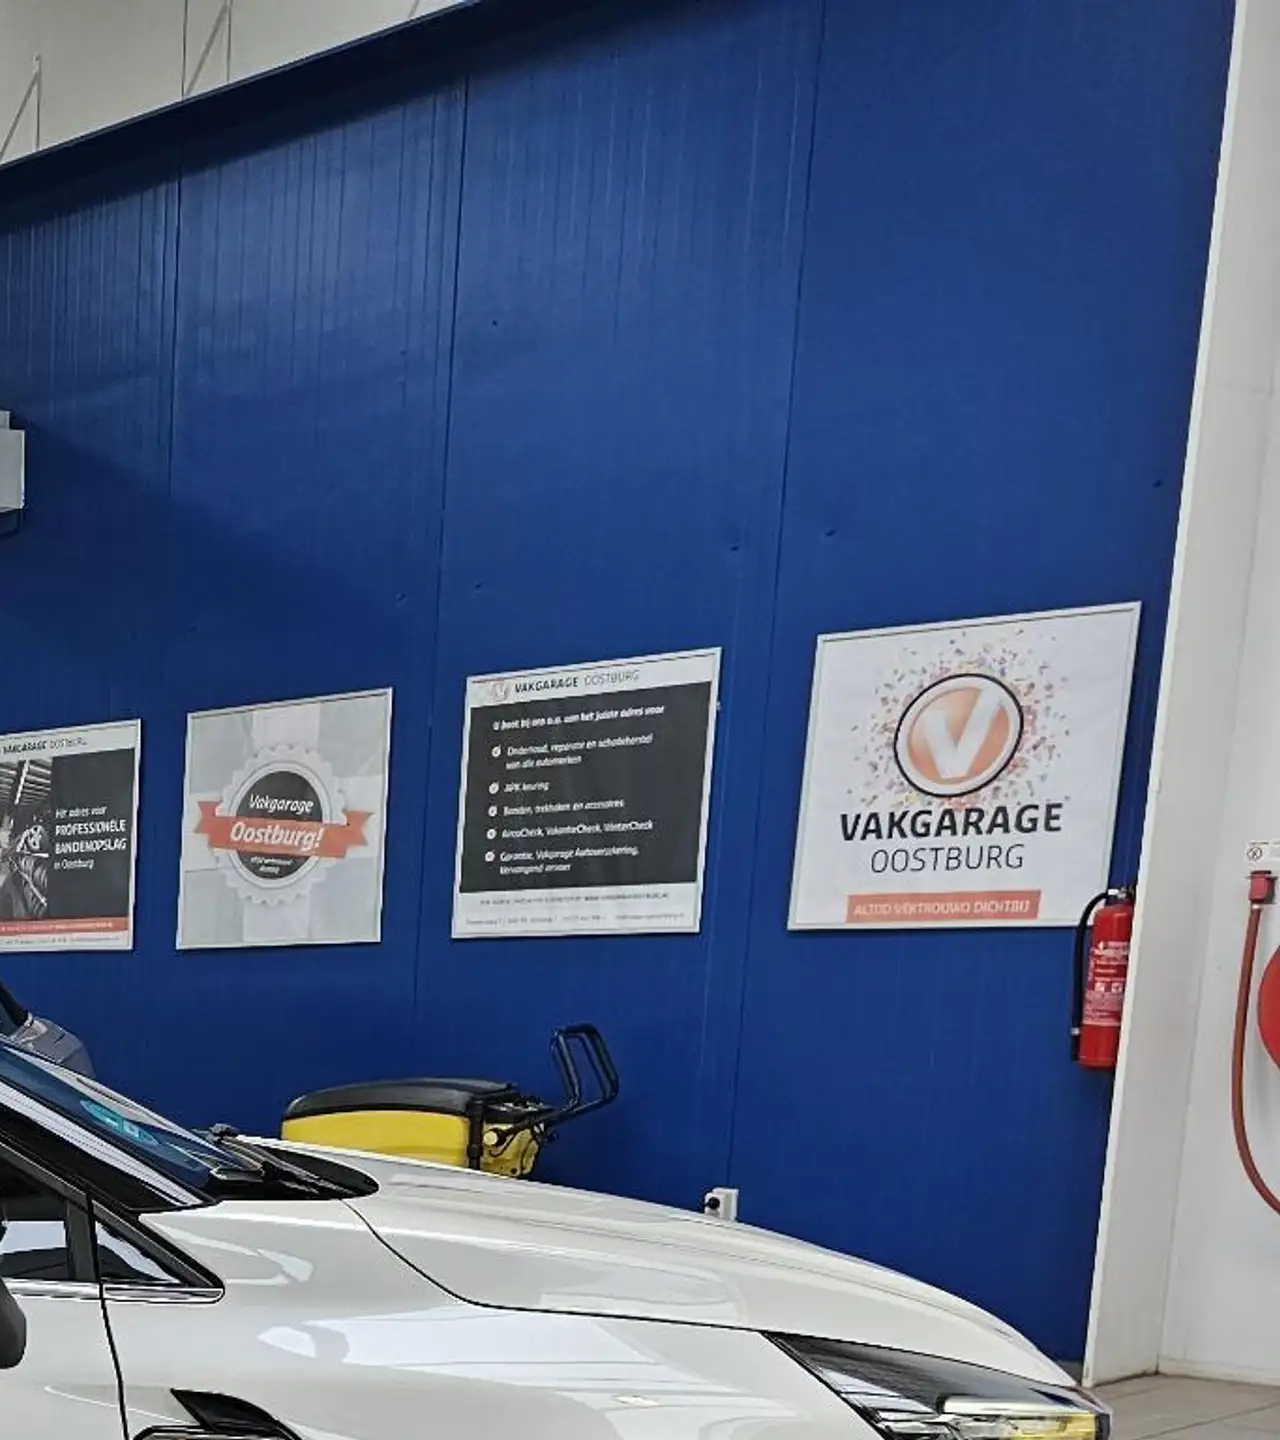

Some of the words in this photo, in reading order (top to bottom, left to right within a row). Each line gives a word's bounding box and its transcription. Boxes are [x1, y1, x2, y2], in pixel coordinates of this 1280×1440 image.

[515, 676, 579, 694] VAKGARAGE
[583, 669, 640, 686] OOSTBURG
[249, 794, 314, 814] Vakgarage
[230, 821, 324, 851] Oostburg!
[841, 803, 1063, 841] VAKGARAGE
[871, 844, 1025, 873] OOSTBURG
